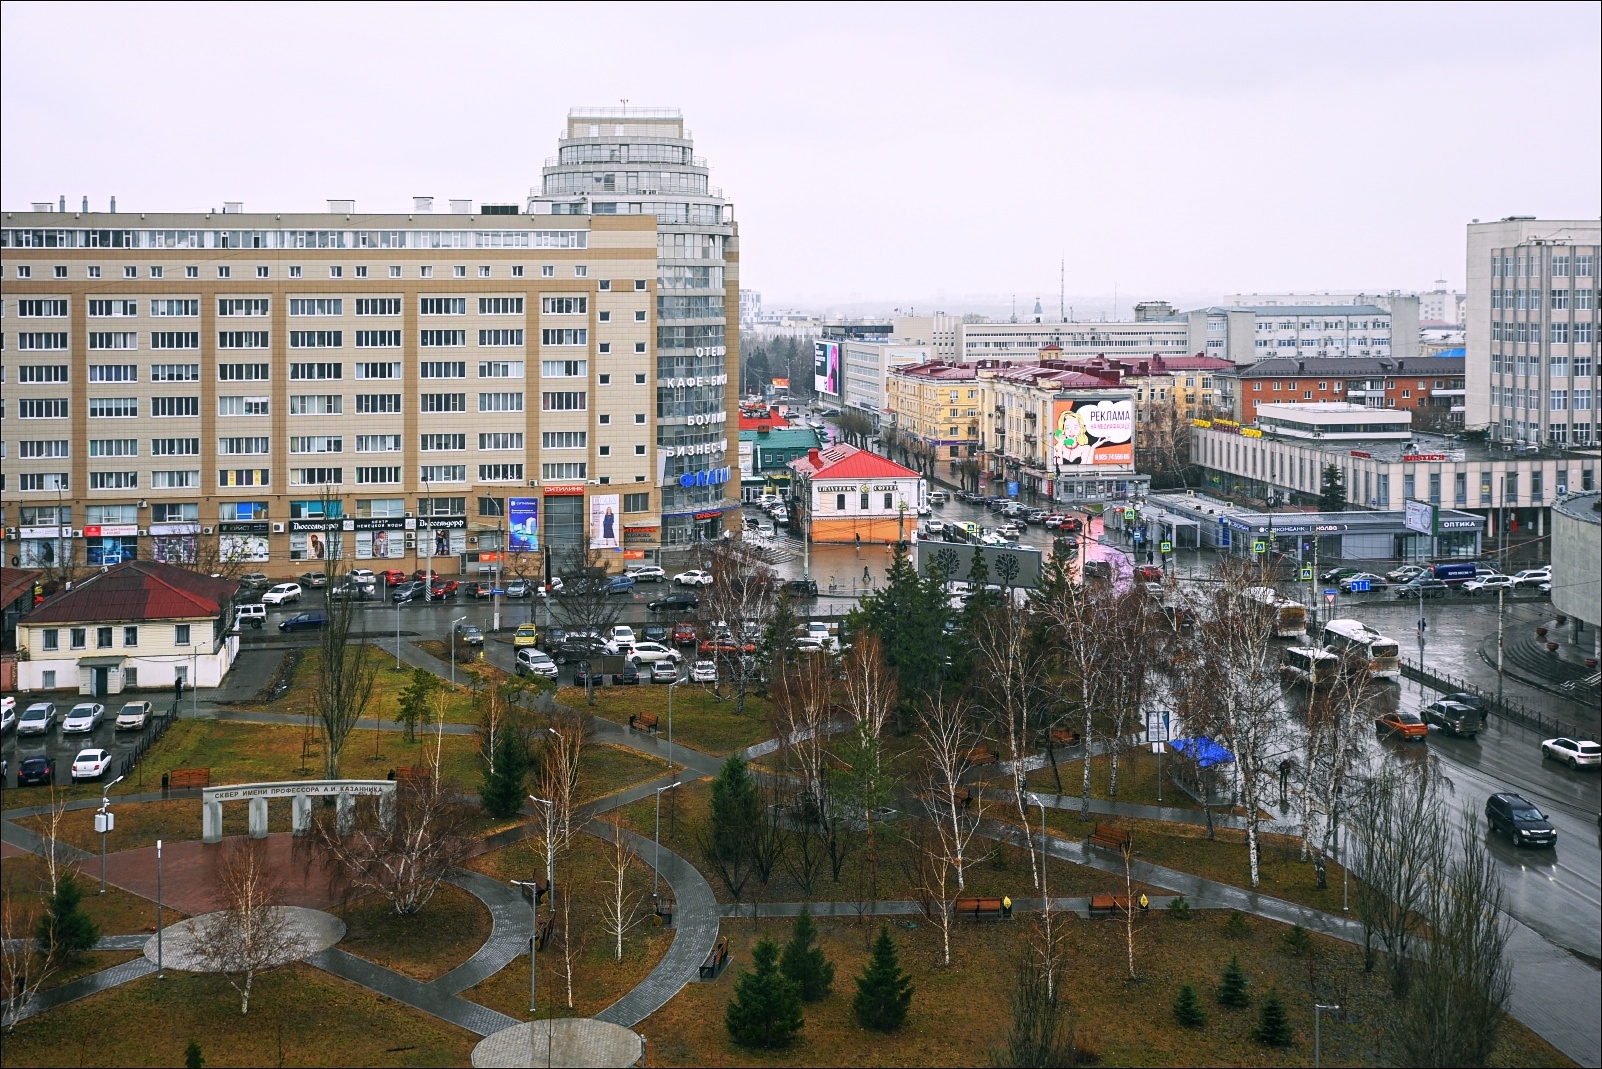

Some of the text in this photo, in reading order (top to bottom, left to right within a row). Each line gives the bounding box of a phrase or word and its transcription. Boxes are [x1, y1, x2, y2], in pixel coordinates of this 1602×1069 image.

[696, 345, 726, 358] ОТЕЛЬ
[1090, 410, 1131, 422] РЕКЛАМА
[418, 518, 464, 528] Дссельдорф
[214, 791, 239, 799] СКВЕР
[242, 788, 268, 797] ИМЕНИ
[271, 786, 320, 794] ПРОФЕССОРА
